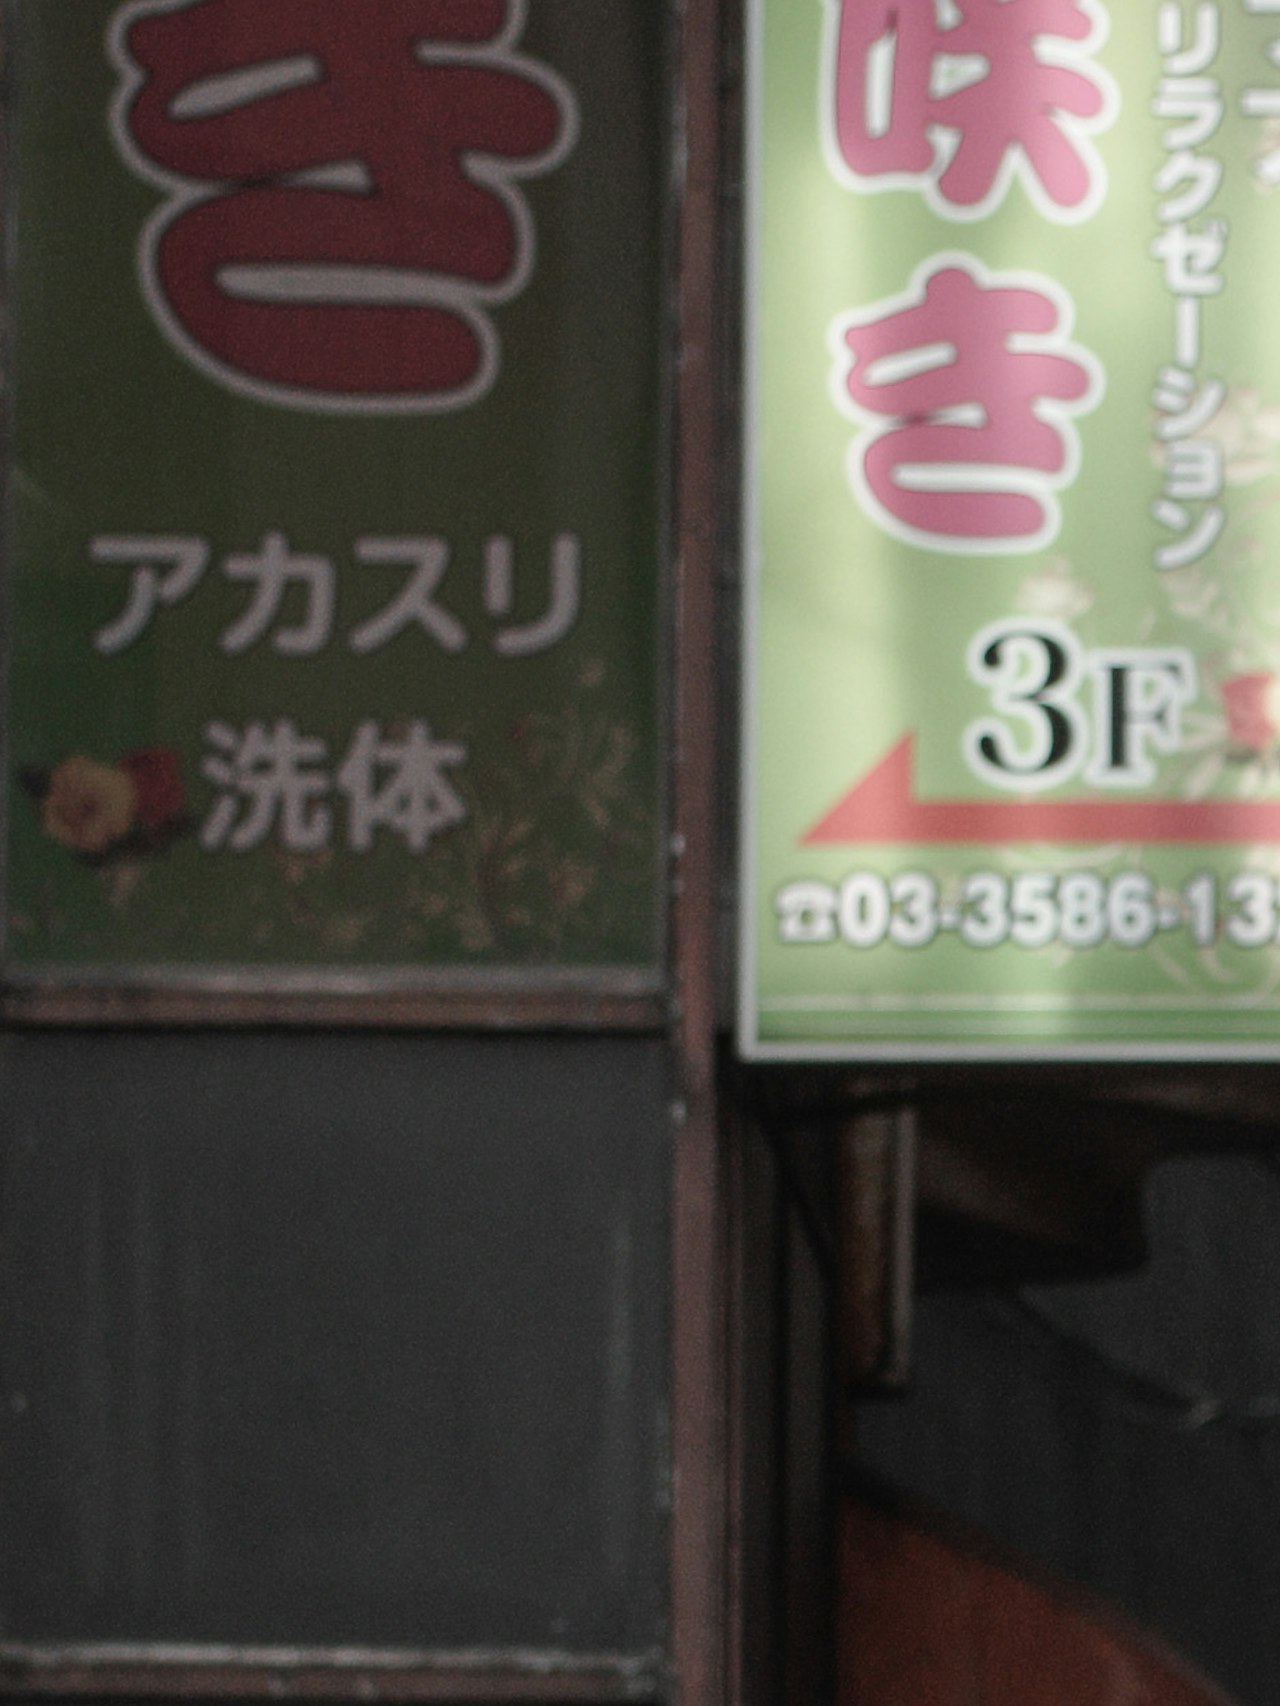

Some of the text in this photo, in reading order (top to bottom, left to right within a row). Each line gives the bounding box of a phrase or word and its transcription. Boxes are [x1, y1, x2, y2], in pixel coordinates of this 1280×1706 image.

[1151, 2, 1228, 569] リラクゼーション
[90, 530, 580, 656] アカスリ
[965, 618, 1196, 787] 3F
[202, 720, 469, 852] 洗体
